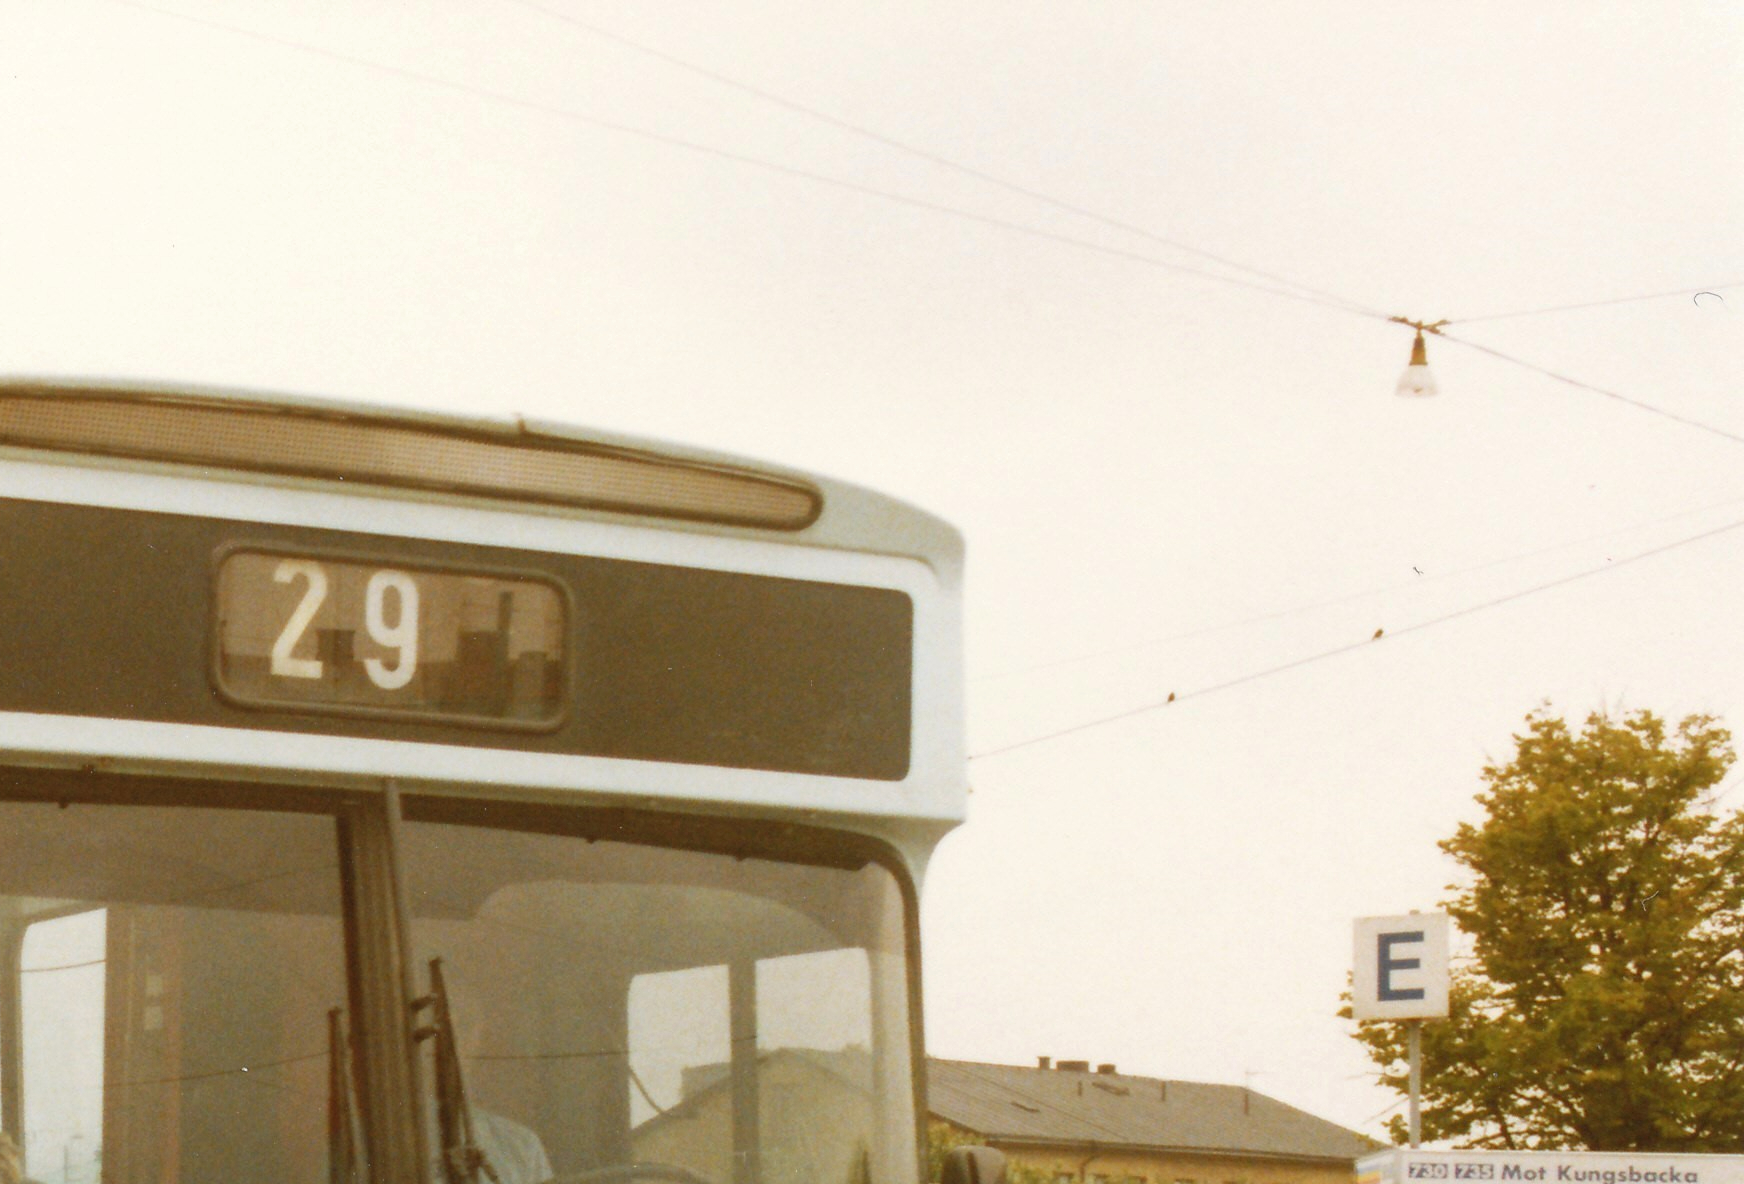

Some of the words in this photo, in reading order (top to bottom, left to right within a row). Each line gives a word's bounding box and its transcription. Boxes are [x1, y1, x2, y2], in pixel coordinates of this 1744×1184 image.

[270, 559, 419, 689] 29
[1377, 931, 1425, 1002] E
[1409, 1163, 1448, 1180] 730
[1502, 1163, 1547, 1182] Mot
